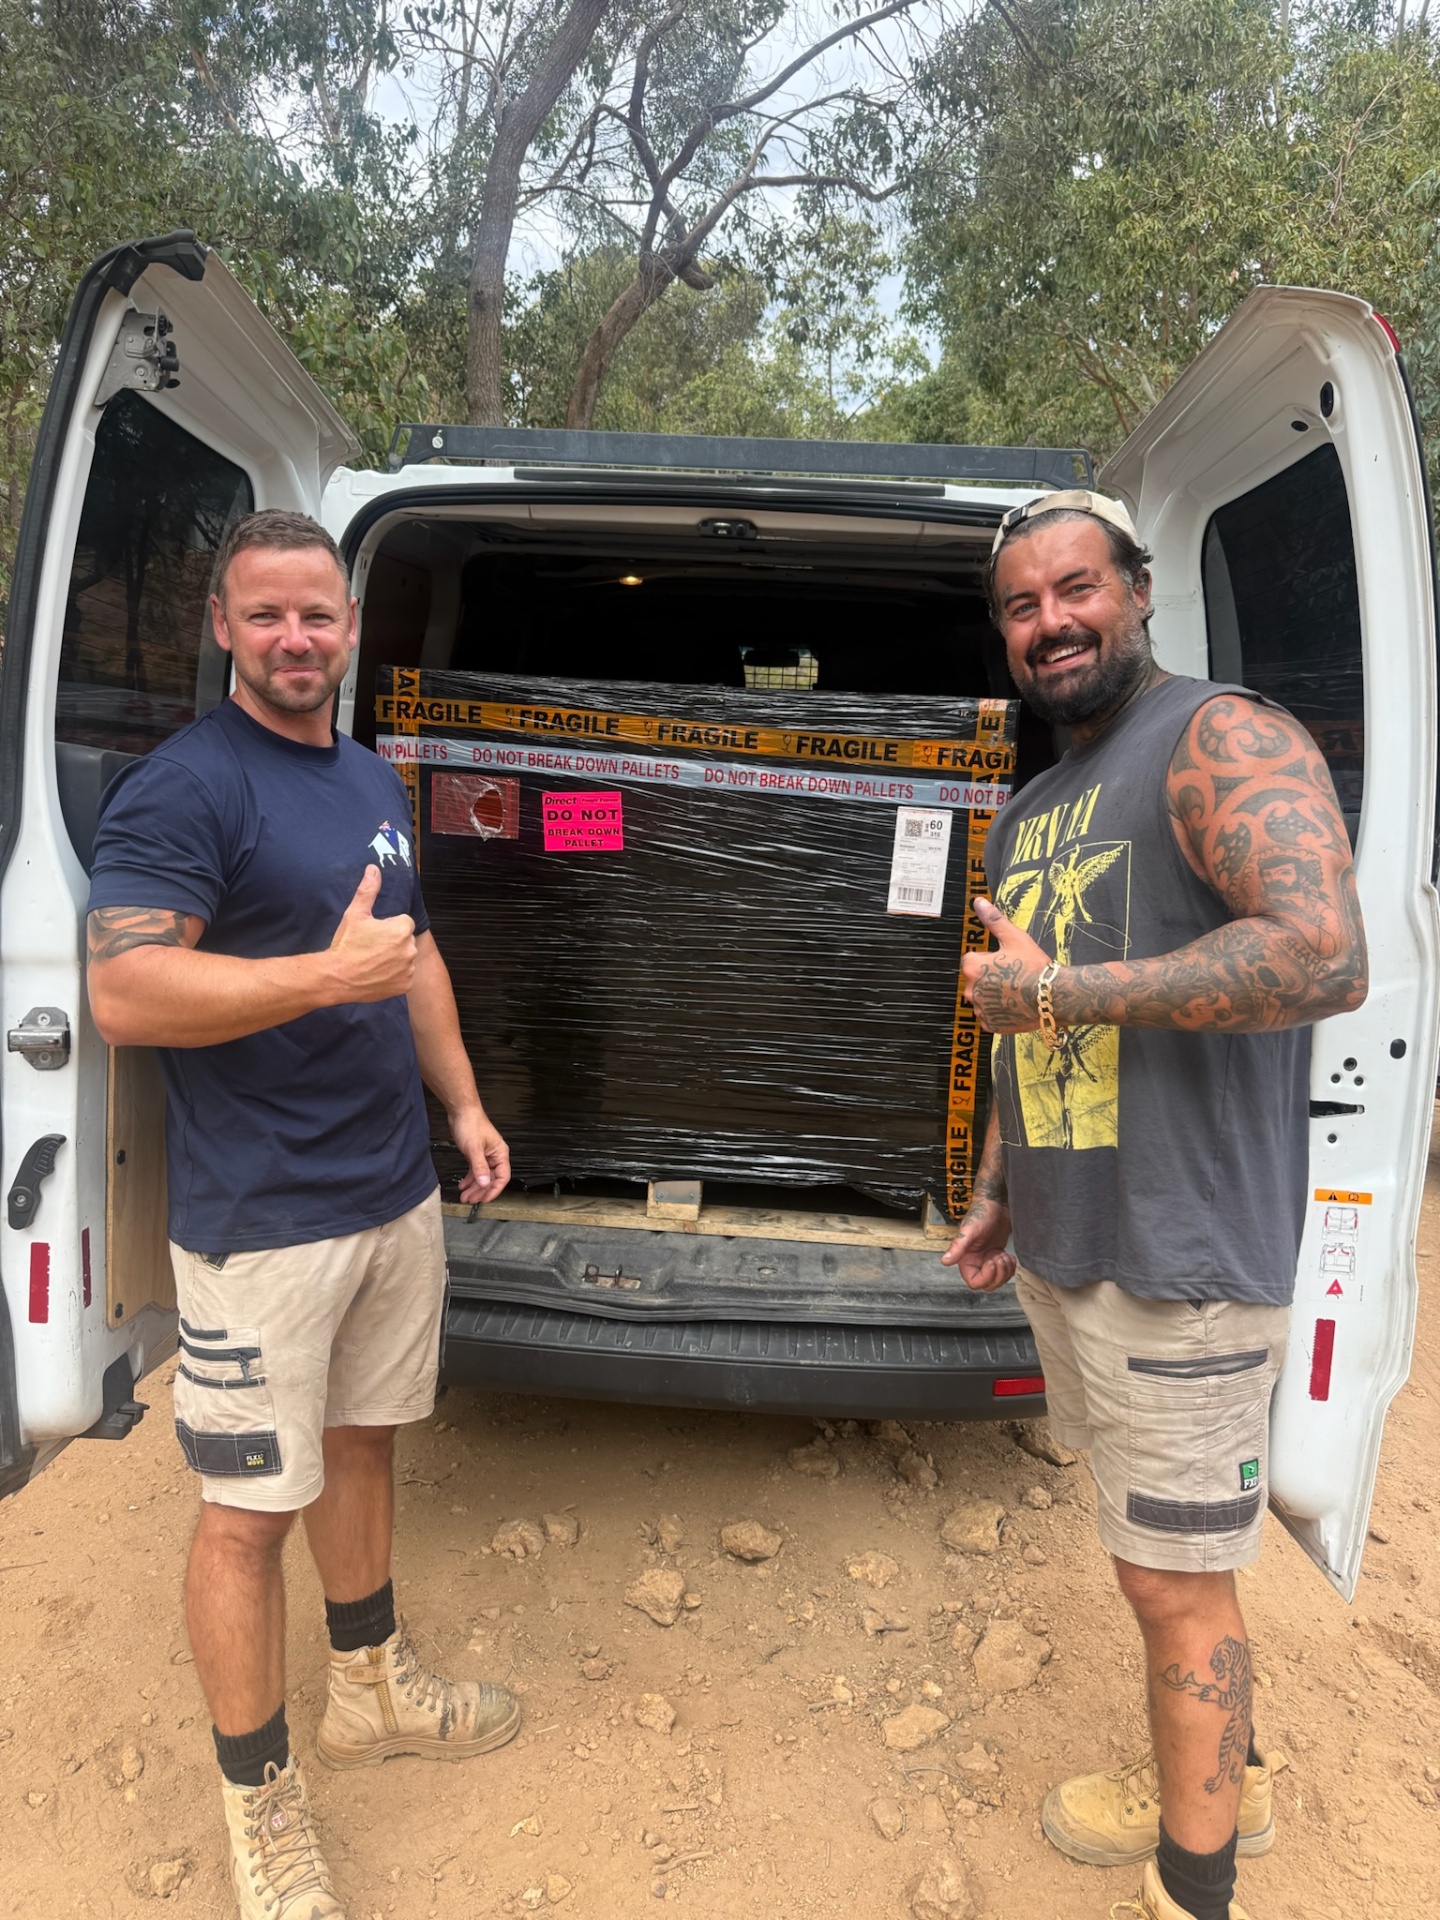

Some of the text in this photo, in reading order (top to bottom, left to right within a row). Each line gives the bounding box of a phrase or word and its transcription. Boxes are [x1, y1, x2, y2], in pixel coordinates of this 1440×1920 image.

[382, 701, 1016, 770] FRAGILE FRAGILE FRAGILE FRAGILE FRAGI
[473, 748, 491, 763] DO
[496, 750, 523, 765] NOT
[528, 752, 572, 770] BREAK
[576, 757, 618, 774] DOWN
[622, 761, 680, 779] PALLETS
[704, 768, 724, 783] DO
[728, 771, 756, 786] NOT
[759, 773, 804, 791] BREAK
[808, 777, 850, 795] DOWN
[855, 781, 914, 800] PALLETS
[939, 787, 960, 802] DO
[963, 788, 993, 804] NOT
[545, 797, 577, 805] Direct
[547, 809, 618, 821] DO NOT
[929, 819, 943, 830] 60
[548, 828, 583, 836] BREAK
[565, 839, 604, 847] PALLET
[950, 1126, 969, 1217] FRAGILE
